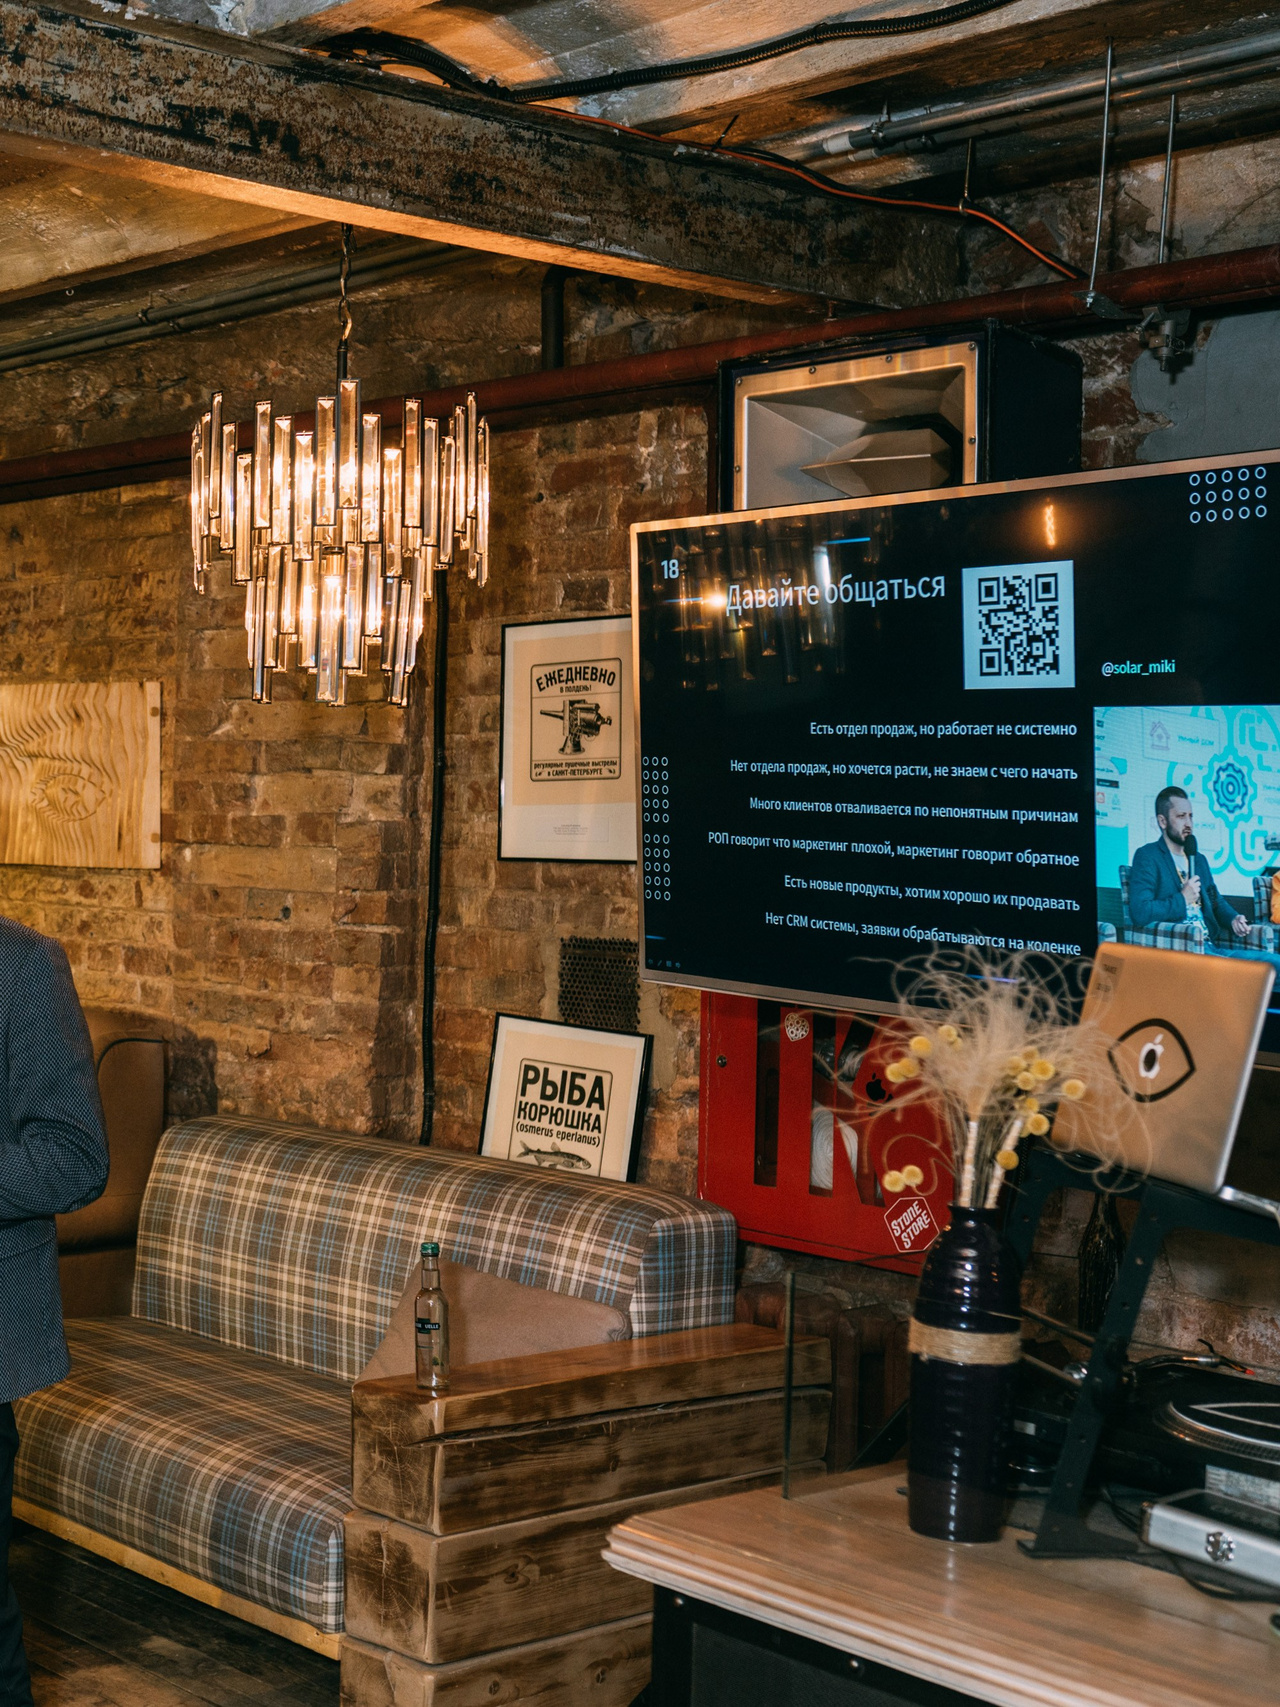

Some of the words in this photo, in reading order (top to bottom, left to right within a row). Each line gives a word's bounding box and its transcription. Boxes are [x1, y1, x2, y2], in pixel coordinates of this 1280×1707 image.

[661, 559, 680, 579] 18
[726, 577, 820, 617] Давайте
[824, 573, 946, 608] общаться
[536, 665, 616, 692] ЕЖЕДНЕВНО
[1101, 659, 1176, 677] @solar_miki
[810, 722, 834, 735] Есть
[835, 724, 868, 738] отдел
[870, 724, 918, 738] продаж,
[919, 724, 935, 736] но
[937, 721, 994, 738] работает
[996, 724, 1012, 736] не
[1014, 724, 1078, 736] системно
[534, 762, 564, 770] регулярные
[565, 761, 590, 769] пушечные
[591, 760, 618, 768] выстрелы
[552, 768, 603, 777] САНКТ-ПЕТЕРБУРГЕ
[730, 759, 748, 772] Нет
[750, 762, 785, 775] отдела
[787, 763, 831, 776] продаж,
[832, 764, 847, 775] но
[848, 764, 892, 776] хочется
[894, 765, 932, 778] расти,
[934, 766, 949, 777] не
[950, 766, 988, 778] знаем
[990, 767, 999, 778] с
[1000, 767, 1029, 779] чего
[1031, 768, 1078, 780] начать
[749, 797, 782, 811] Много
[783, 800, 833, 813] клиентов
[834, 802, 912, 816] отваливается
[914, 806, 929, 817] по
[931, 806, 1008, 820] непонятным
[1011, 809, 1079, 824] причинам
[708, 831, 729, 845] РОП
[730, 834, 770, 849] говорит
[772, 838, 791, 849] что
[792, 839, 848, 853] маркетинг
[851, 841, 895, 857] плохой,
[897, 845, 959, 860] маркетинг
[962, 848, 1013, 864] говорит
[1015, 849, 1080, 867] обратное
[784, 875, 808, 889] Есть
[809, 879, 844, 892] новые
[845, 882, 903, 899] продукты,
[905, 886, 940, 899] хотим
[943, 889, 991, 905] хорошо
[993, 894, 1008, 905] их
[1010, 895, 1080, 911] продавать
[765, 912, 784, 925] Нет
[786, 914, 808, 928] CRM
[810, 918, 859, 935] системы,
[861, 923, 900, 938] заявки
[902, 925, 1006, 948] обрабатываются
[1008, 938, 1024, 950] на
[1027, 940, 1081, 956] коленке
[520, 1063, 605, 1111] РЫБА
[517, 1100, 602, 1134] КОРЮШКА
[515, 1121, 554, 1138] (osmerus
[556, 1129, 601, 1148] eperlanus)
[891, 1200, 922, 1237] STONE
[901, 1210, 931, 1249] STORE
